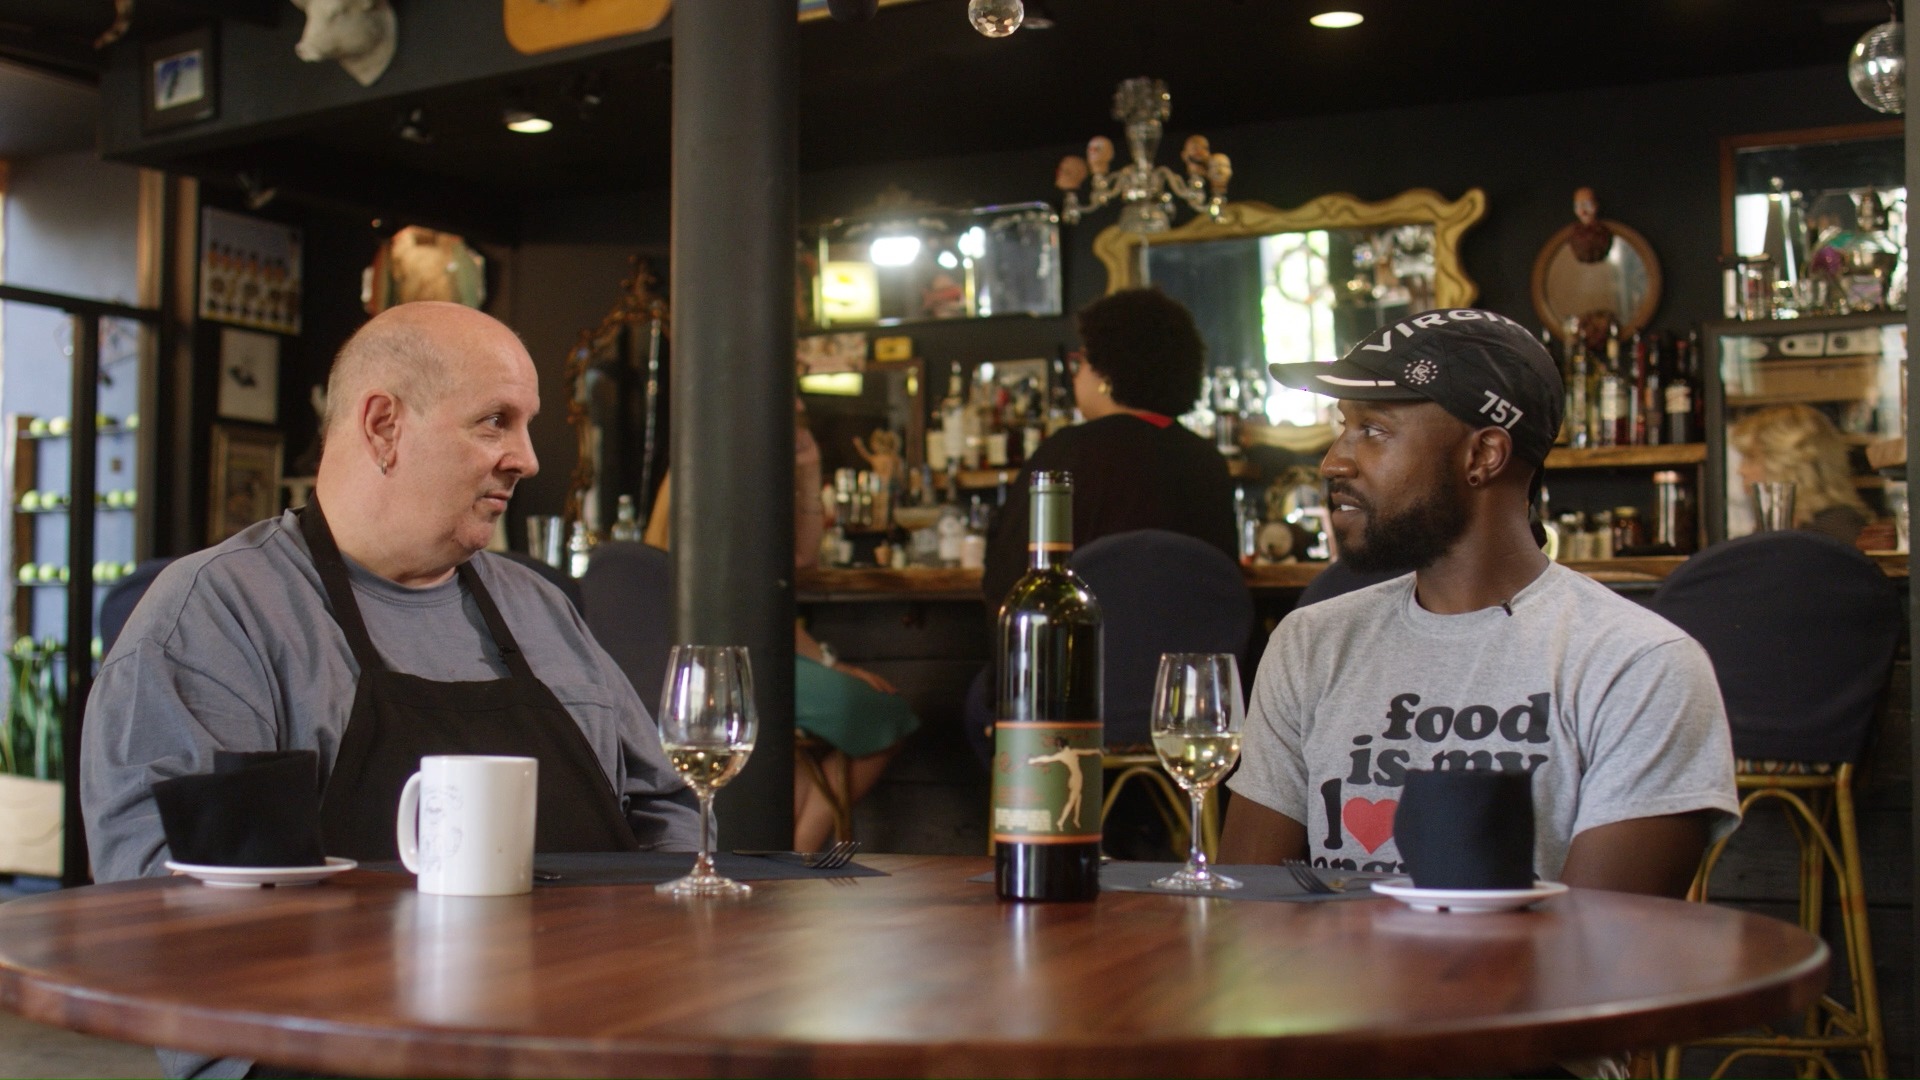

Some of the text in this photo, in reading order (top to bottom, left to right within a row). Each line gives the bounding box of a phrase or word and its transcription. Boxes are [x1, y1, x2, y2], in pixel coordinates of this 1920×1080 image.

[1479, 390, 1523, 429] 757
[1382, 692, 1551, 743] food
[1346, 735, 1411, 787] is
